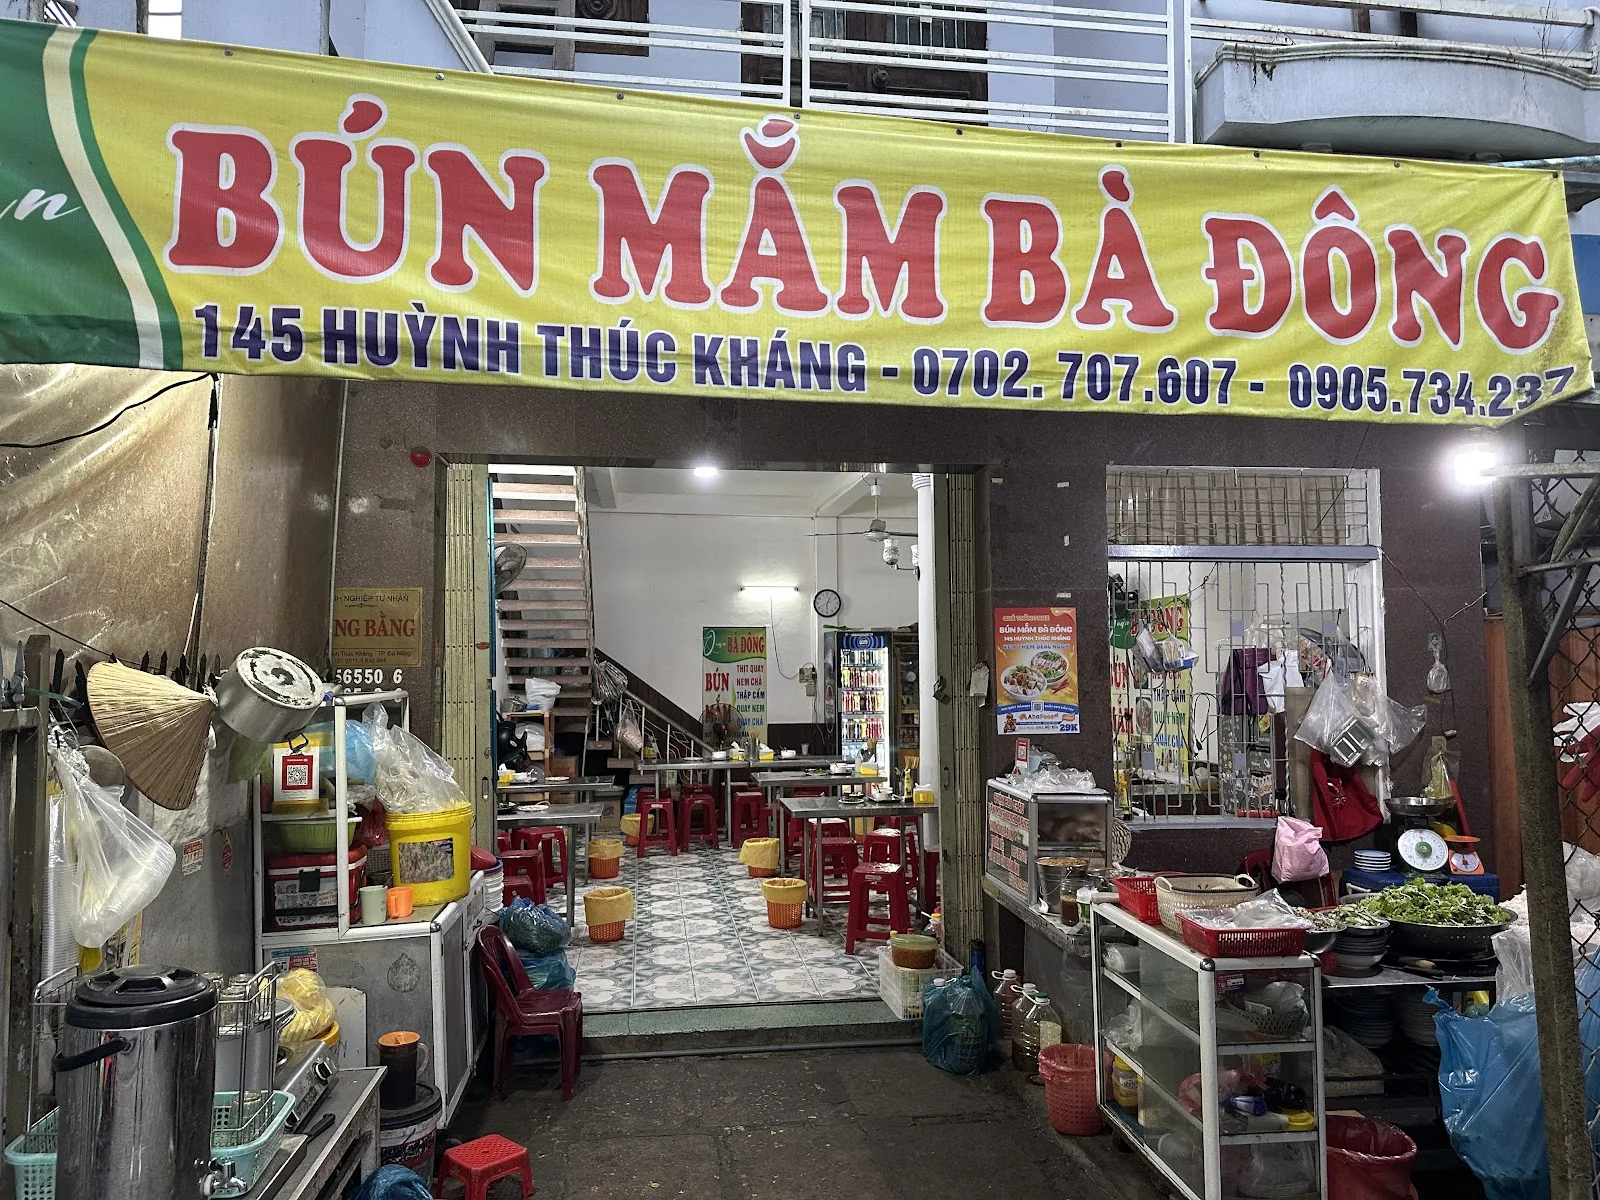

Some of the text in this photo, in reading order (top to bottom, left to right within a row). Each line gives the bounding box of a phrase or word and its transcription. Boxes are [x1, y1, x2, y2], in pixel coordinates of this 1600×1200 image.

[166, 93, 1562, 354] BÚN MẮM BÀ ĐÔNG
[195, 304, 304, 362] 145
[323, 302, 520, 374] HUỲNH
[537, 317, 677, 385] THÚC
[695, 327, 866, 394] KHÁNG
[1057, 352, 1237, 406] 707.607
[1289, 363, 1576, 418] 0905.734.237
[364, 611, 416, 637] BẰNG
[999, 624, 1016, 634] BÚN
[1038, 624, 1049, 634] BÀ
[1049, 624, 1073, 634] ĐÔNG
[740, 631, 764, 653] ĐÔNG
[750, 664, 764, 673] QUAY
[705, 667, 729, 692] BÚN
[736, 677, 749, 686] NEM
[752, 704, 765, 713] NEM
[1059, 723, 1078, 732] 29K
